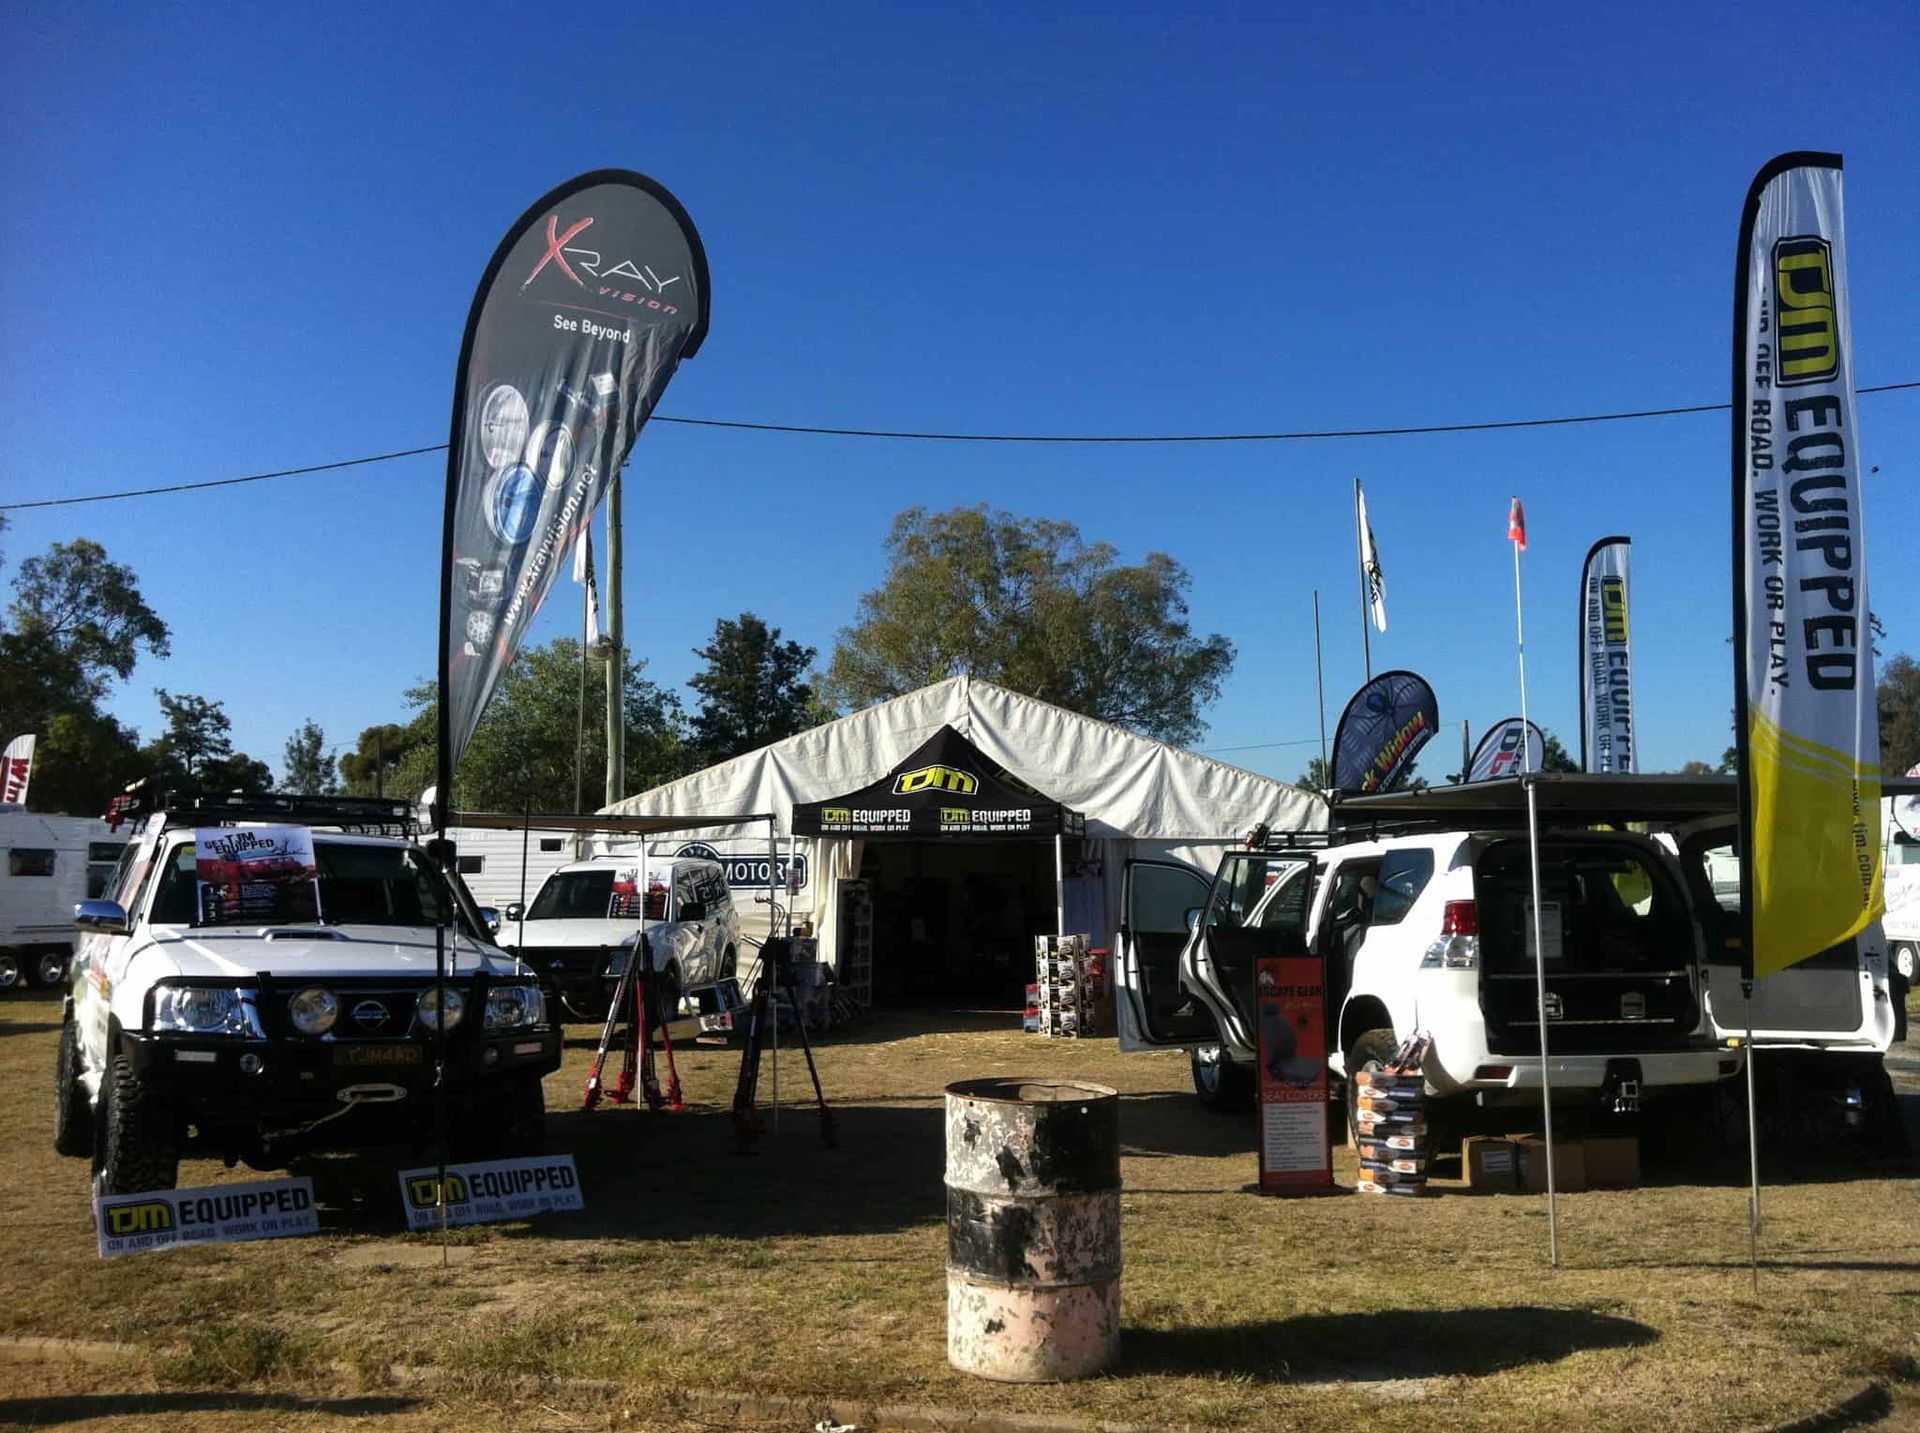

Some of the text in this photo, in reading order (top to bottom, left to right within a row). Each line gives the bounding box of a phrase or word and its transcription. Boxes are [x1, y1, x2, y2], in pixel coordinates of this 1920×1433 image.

[554, 314, 630, 343] See Beyond
[1751, 400, 1773, 477] ROAD.
[504, 462, 597, 626] www.xrayvision.net
[1754, 489, 1783, 566] WORK
[1782, 394, 1856, 690] EQUIPPED
[1764, 576, 1785, 610] OR
[1590, 626, 1603, 647] OFF
[1770, 621, 1789, 695] PLAY.
[1596, 692, 1611, 729] WORK
[1608, 651, 1631, 773] EQUIPPE
[1374, 710, 1425, 773] Widow
[852, 809, 911, 823] EQUIPPED
[972, 809, 1031, 823] EQUIPPED
[725, 862, 799, 880] MOTOR
[469, 1166, 575, 1198] EQUIPPED
[179, 1188, 310, 1225] EQUIPPED
[107, 1240, 123, 1250] ON
[129, 1237, 152, 1249] AND
[157, 1233, 178, 1245] OFF
[263, 1221, 278, 1232] OR
